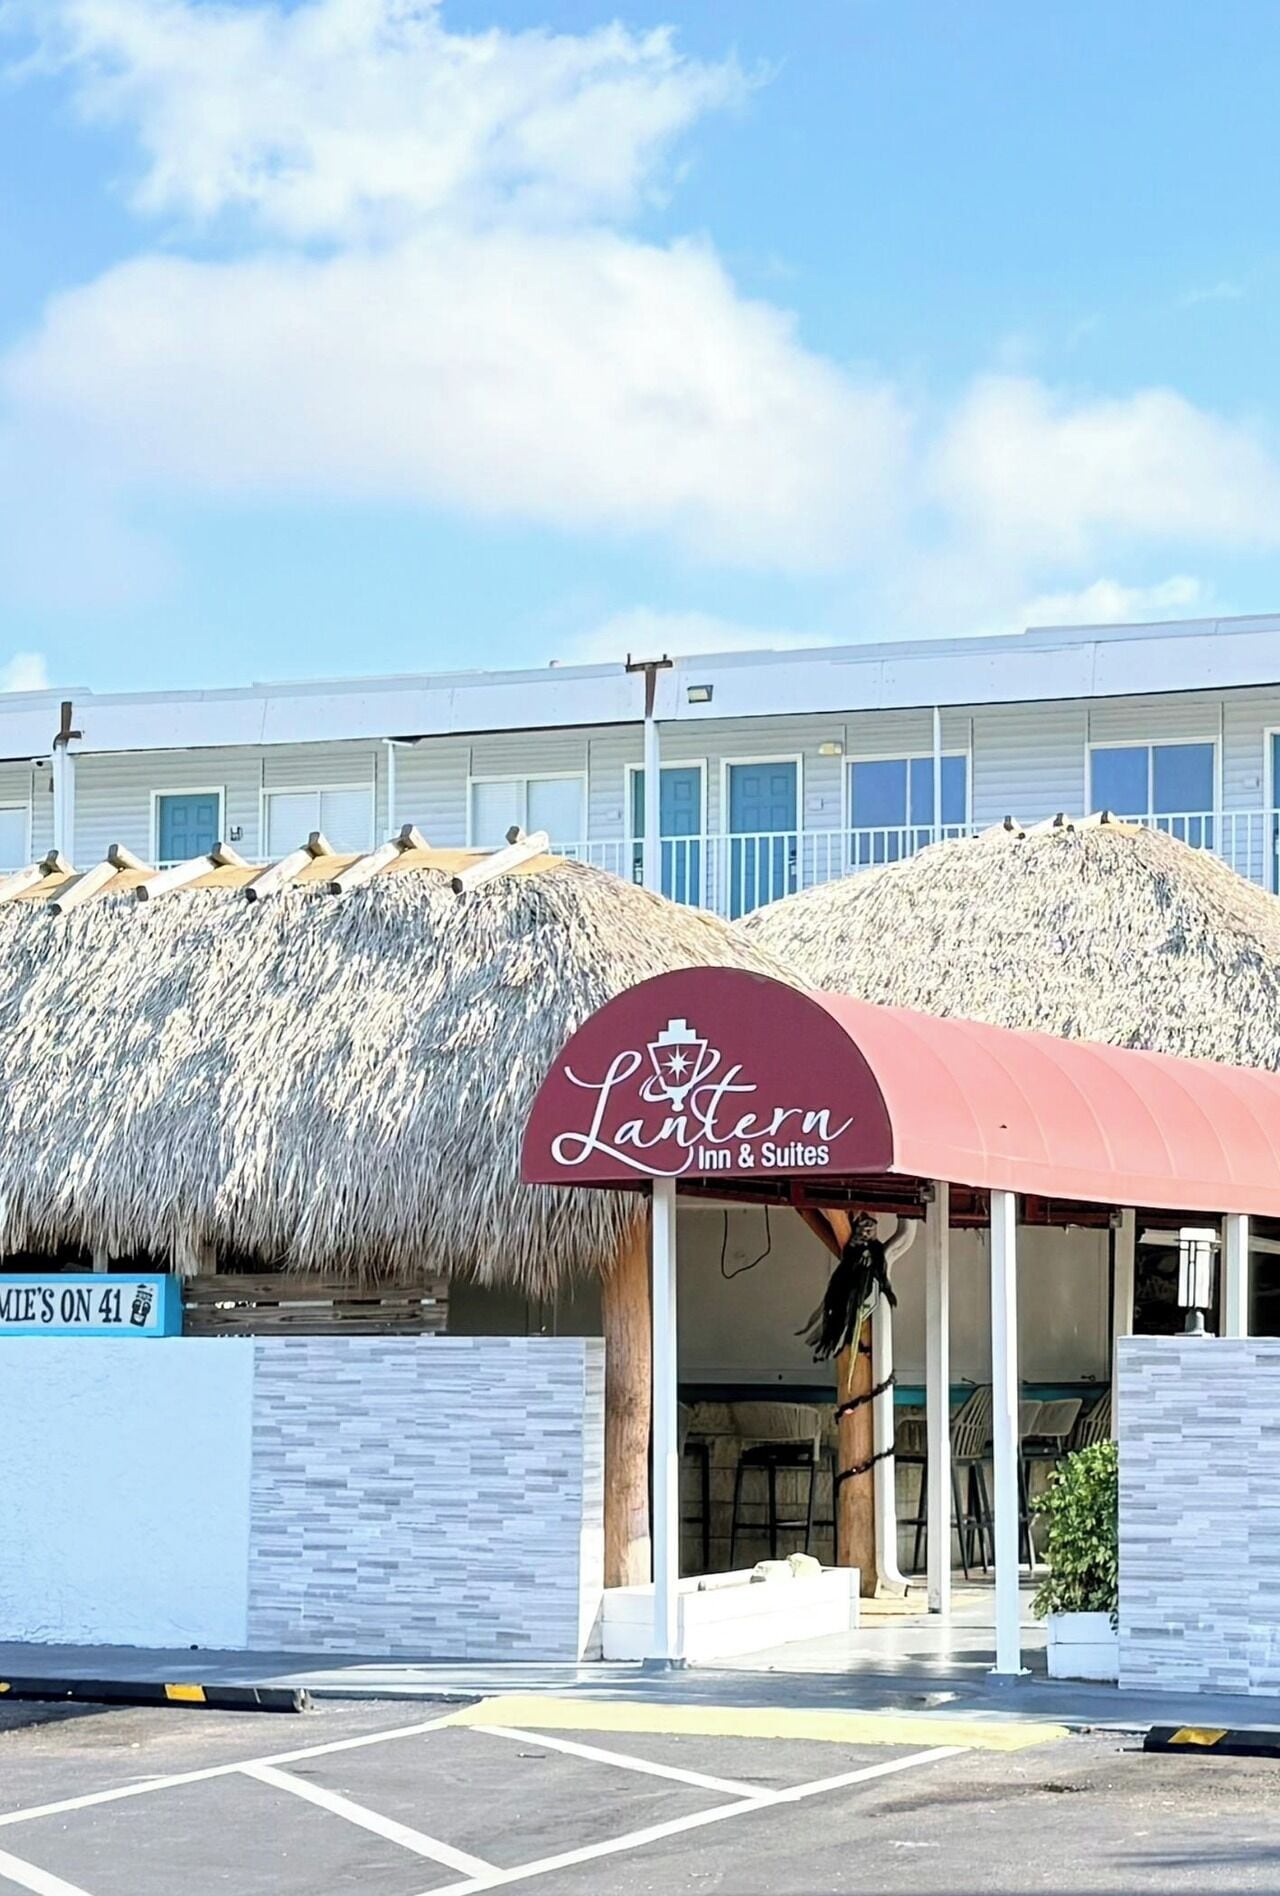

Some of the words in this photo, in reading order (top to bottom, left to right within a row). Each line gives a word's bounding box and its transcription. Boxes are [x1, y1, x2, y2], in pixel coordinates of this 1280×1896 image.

[551, 1049, 854, 1177] Lantern
[698, 1145, 731, 1170] Inn
[738, 1144, 755, 1169] &
[761, 1142, 830, 1168] Suites
[61, 1288, 93, 1323] ON
[98, 1288, 122, 1323] 41
